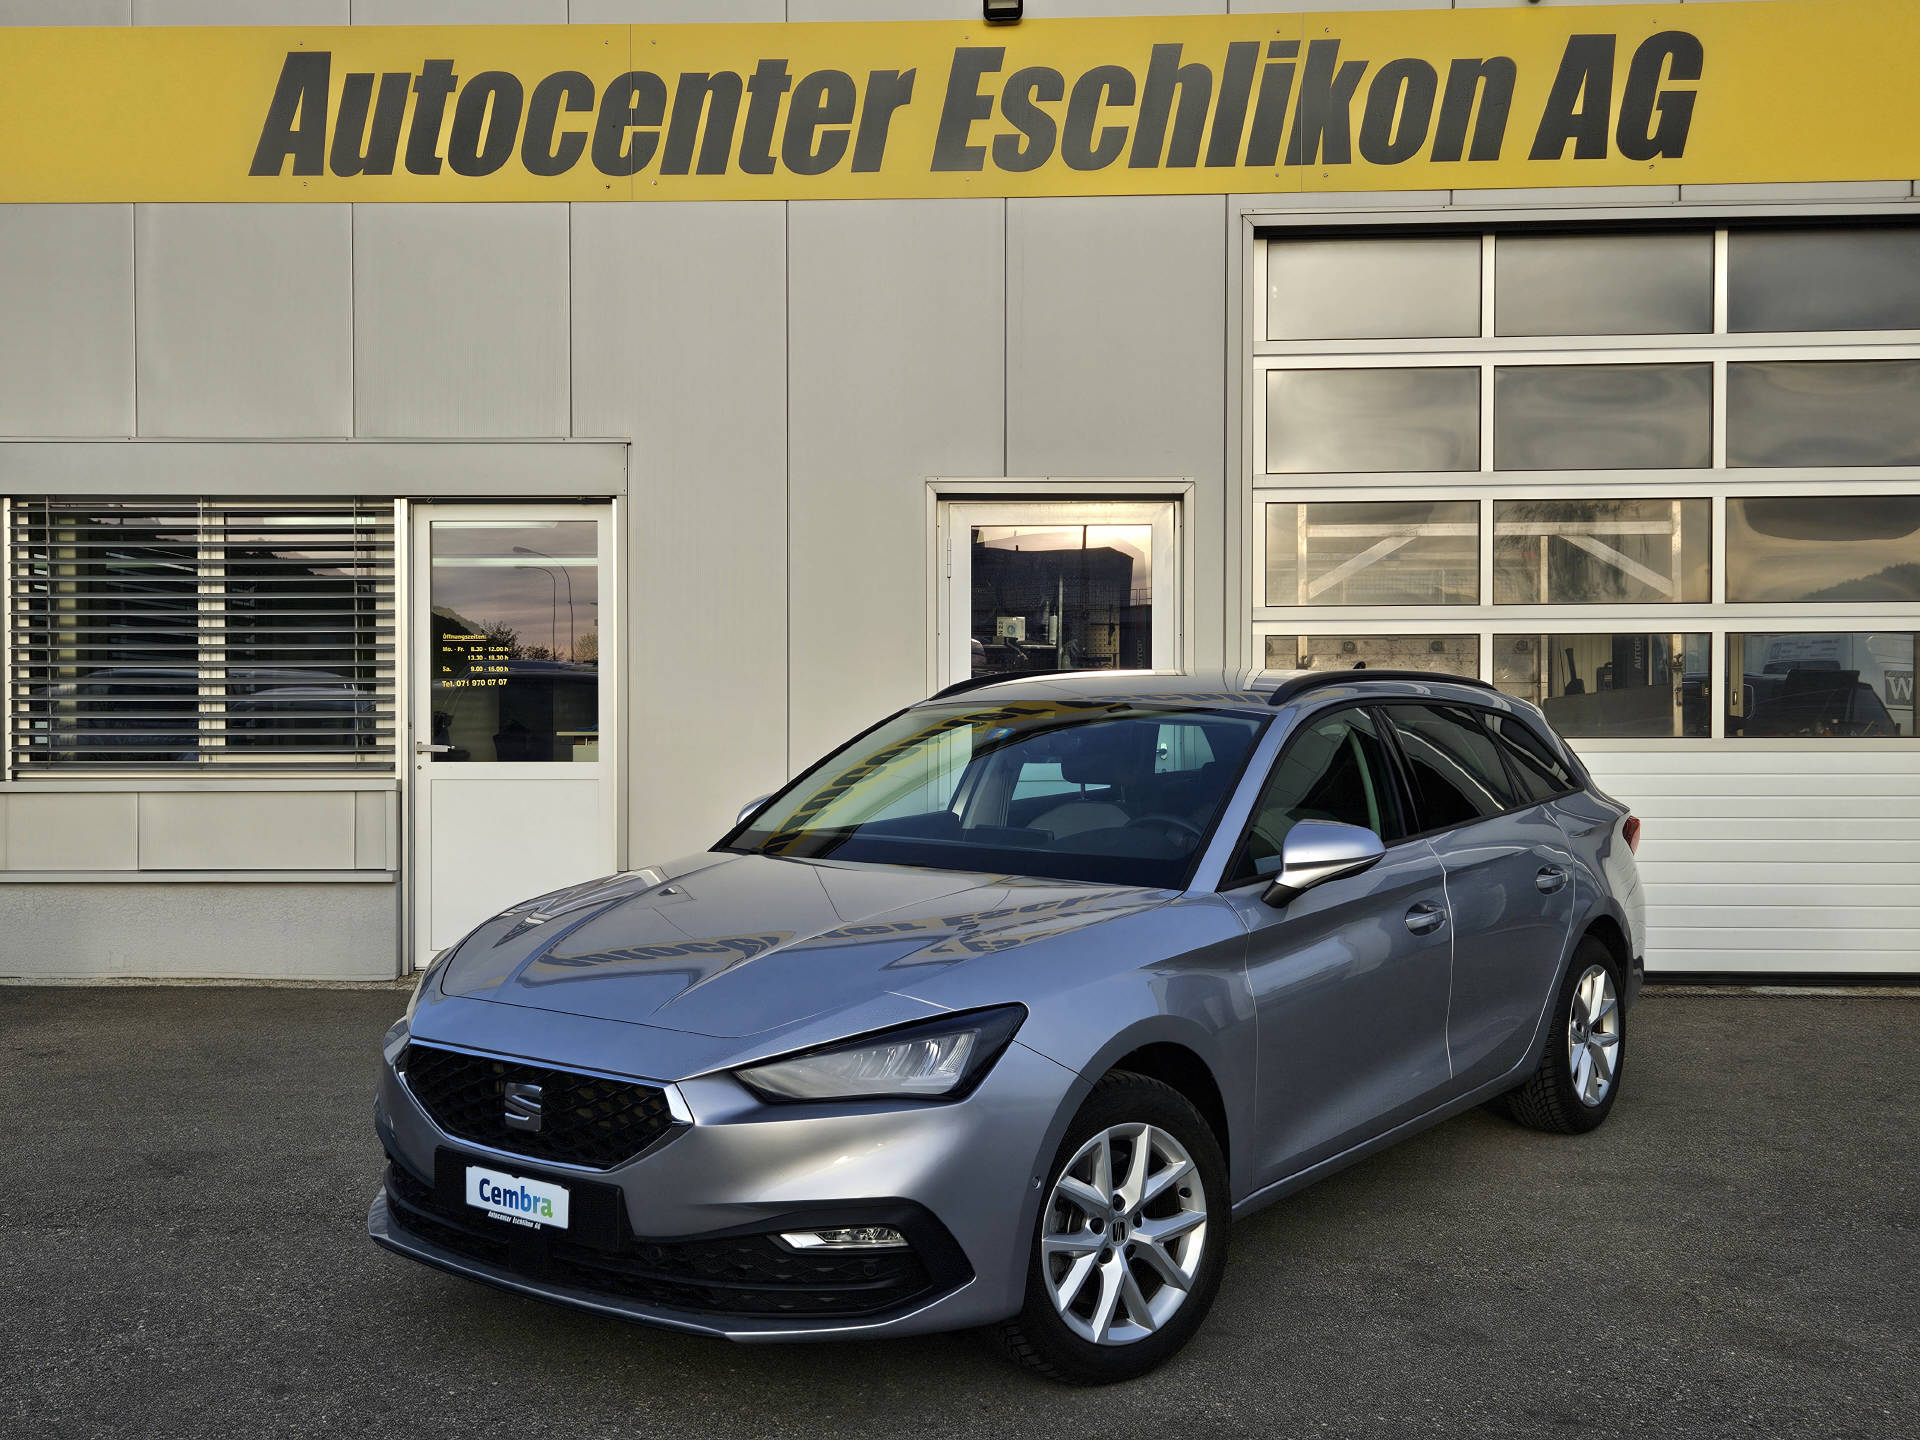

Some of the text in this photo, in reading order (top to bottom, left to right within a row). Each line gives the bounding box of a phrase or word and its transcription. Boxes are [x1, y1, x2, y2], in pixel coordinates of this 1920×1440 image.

[248, 30, 1705, 177] Autocenter Eschlikon AG
[441, 680, 455, 688] Tel.
[471, 679, 486, 687] 970
[498, 678, 508, 686] 07
[479, 1177, 553, 1219] Cembra
